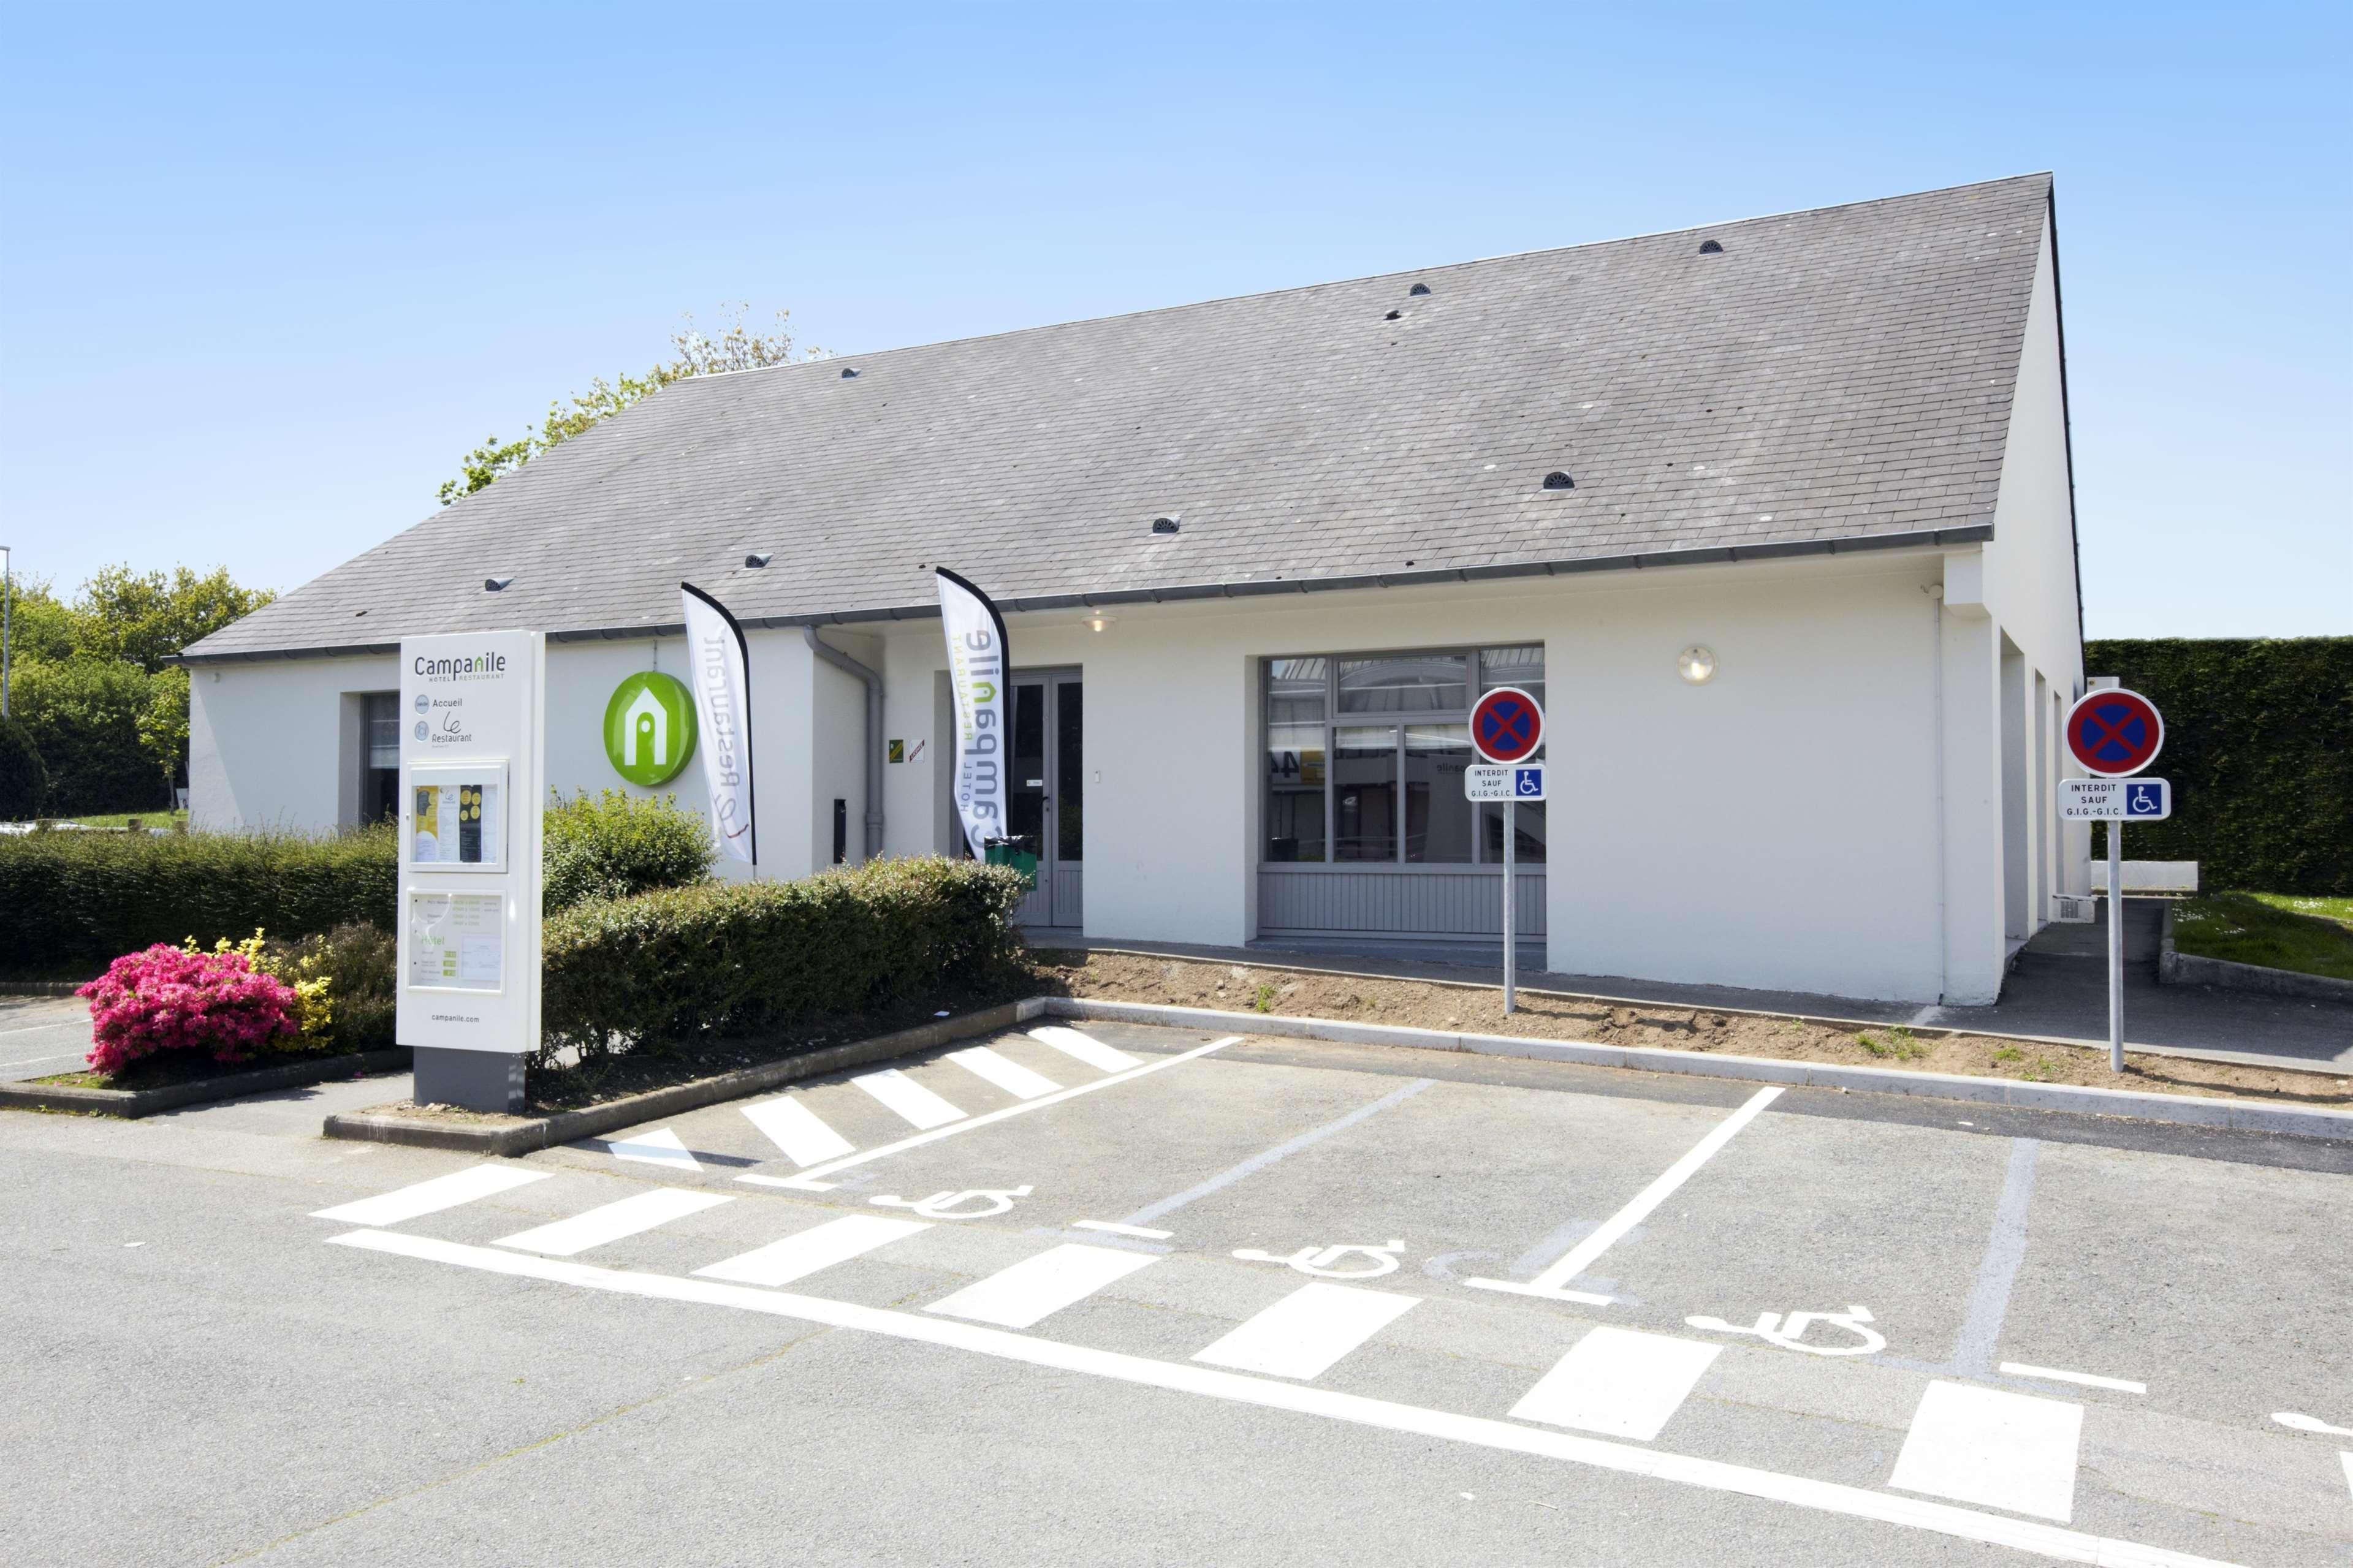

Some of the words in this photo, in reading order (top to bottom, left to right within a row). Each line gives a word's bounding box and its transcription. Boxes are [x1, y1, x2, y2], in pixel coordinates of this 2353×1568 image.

[415, 651, 506, 681] Campanile
[432, 698, 462, 707] Accueil
[431, 733, 472, 743] Restaurant
[2071, 784, 2116, 792] INTERDIT
[431, 1014, 480, 1023] campanile.com
